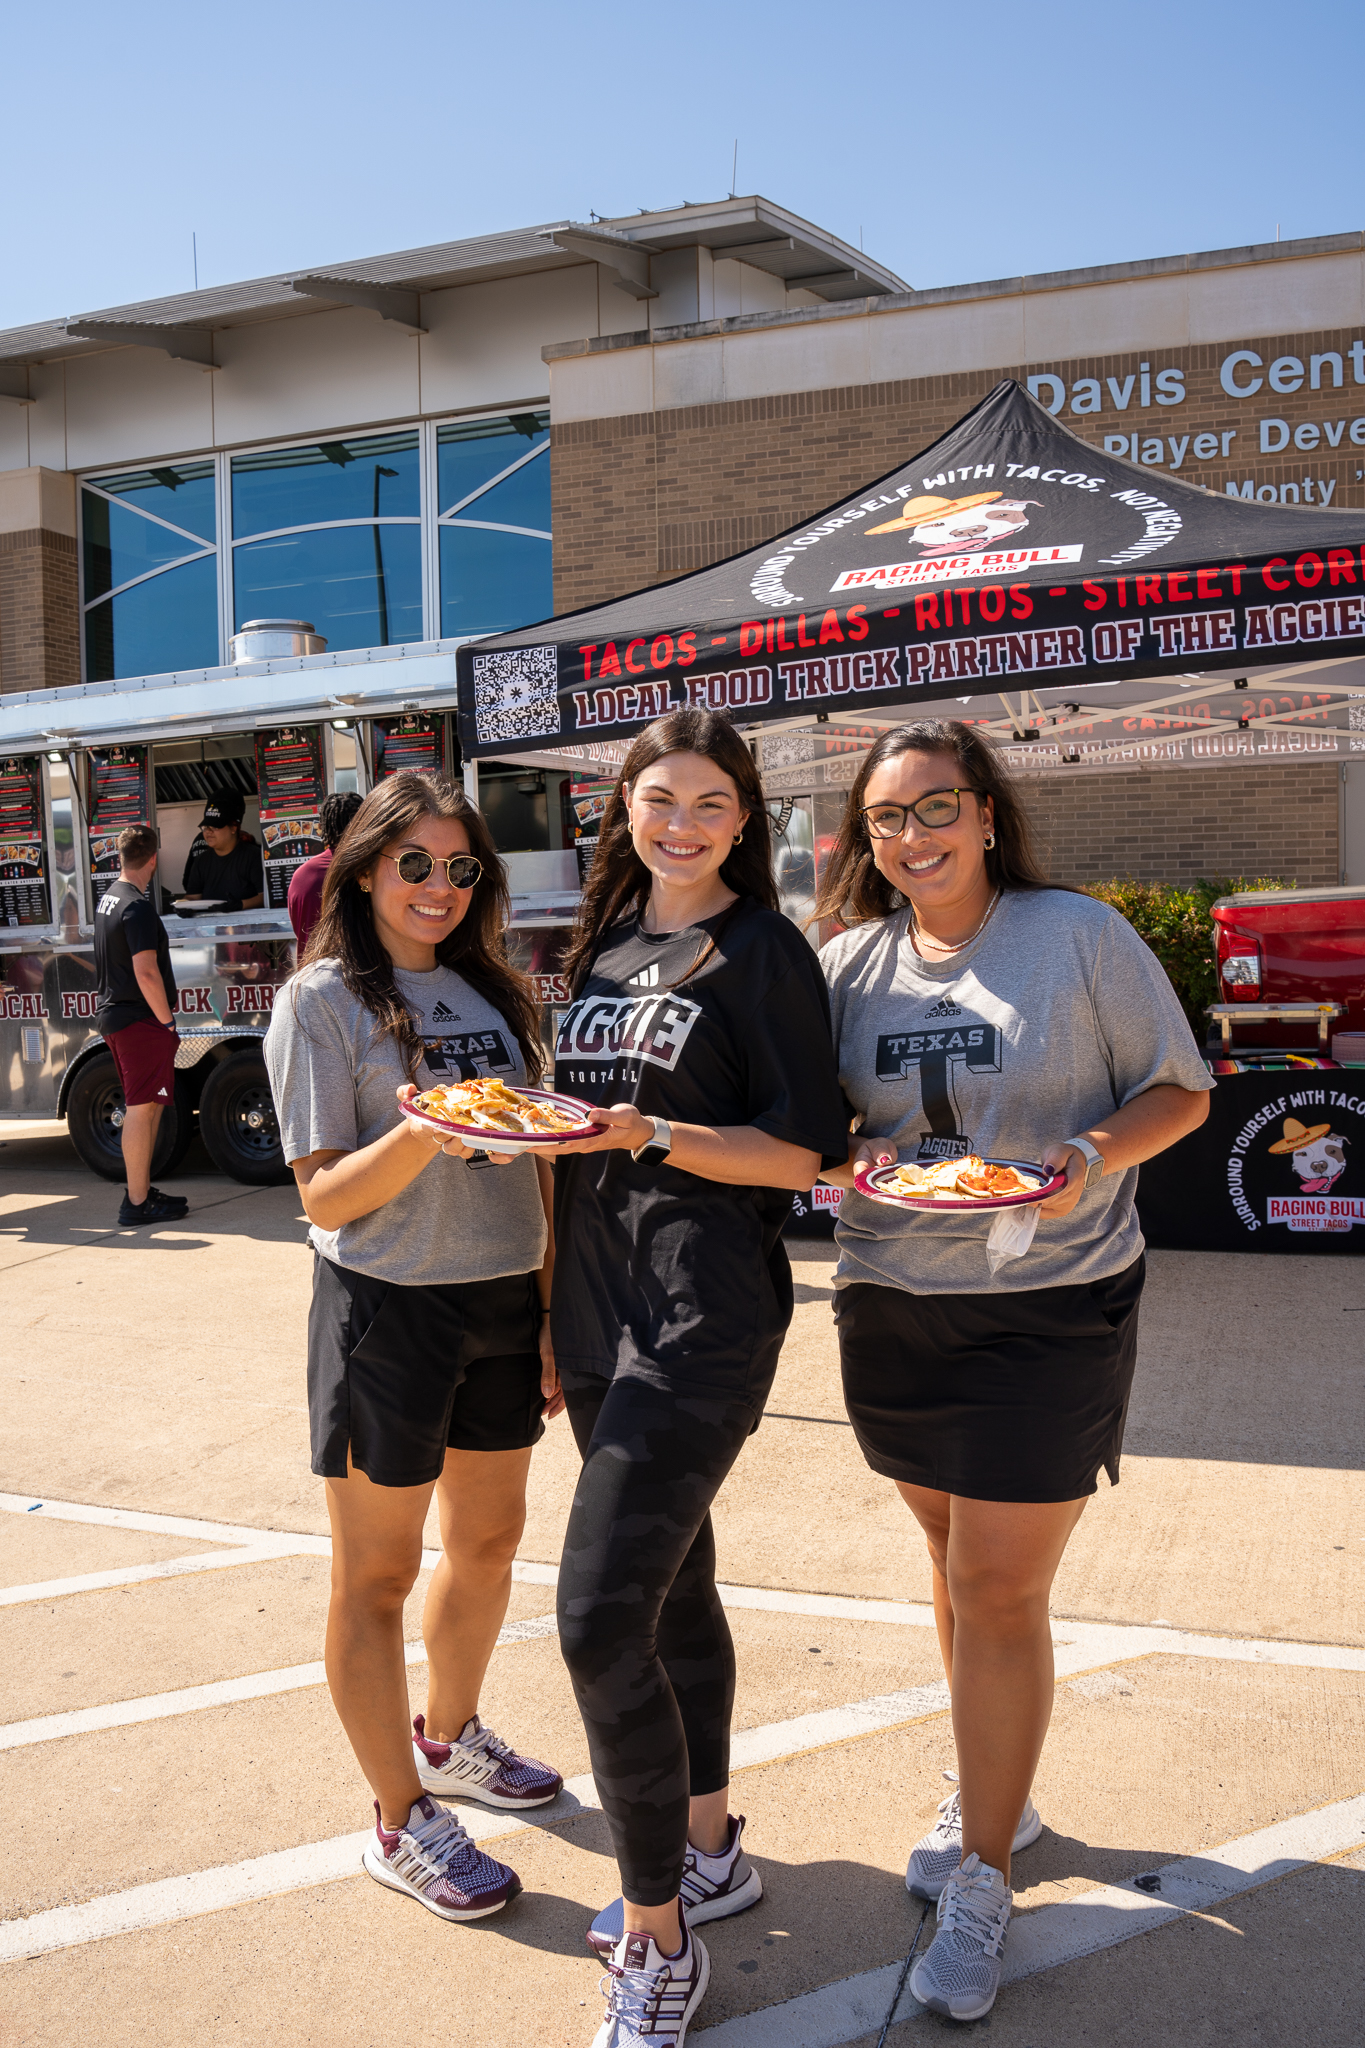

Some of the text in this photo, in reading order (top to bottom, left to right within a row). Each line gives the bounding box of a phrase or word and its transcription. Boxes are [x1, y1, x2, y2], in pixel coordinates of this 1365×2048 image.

[1026, 362, 1186, 416] Davis
[1104, 430, 1236, 469] Player
[1226, 476, 1336, 507] Monty
[749, 463, 1183, 607] SURROUND YOURSELF WITH TACOS, NOT NEGATIVITY
[842, 548, 1069, 587] RAGING BULL
[885, 571, 951, 586] STREET
[962, 565, 1018, 576] TACOS
[579, 631, 697, 680] TACOS
[739, 604, 869, 657] DILLAS
[914, 583, 1034, 631] RITOS
[1082, 564, 1247, 611] STREET
[1261, 544, 1365, 591] COR
[573, 595, 1365, 729] LOCAL FOOD TRUCK PARTNER OF THE AGGIE
[432, 1014, 461, 1023] adidas
[924, 1007, 961, 1019] adidas
[423, 1034, 497, 1055] TEXAS
[887, 1029, 984, 1055] TEXAS
[570, 1068, 638, 1083] FOOTALL
[1290, 1089, 1325, 1108] WITH
[1231, 1097, 1287, 1155] YOURSELF
[920, 1136, 966, 1158] AGGIES
[1227, 1158, 1261, 1231] SURROUND
[1271, 1200, 1365, 1218] RAGING BULL
[1291, 1218, 1348, 1228] STREET TACOS
